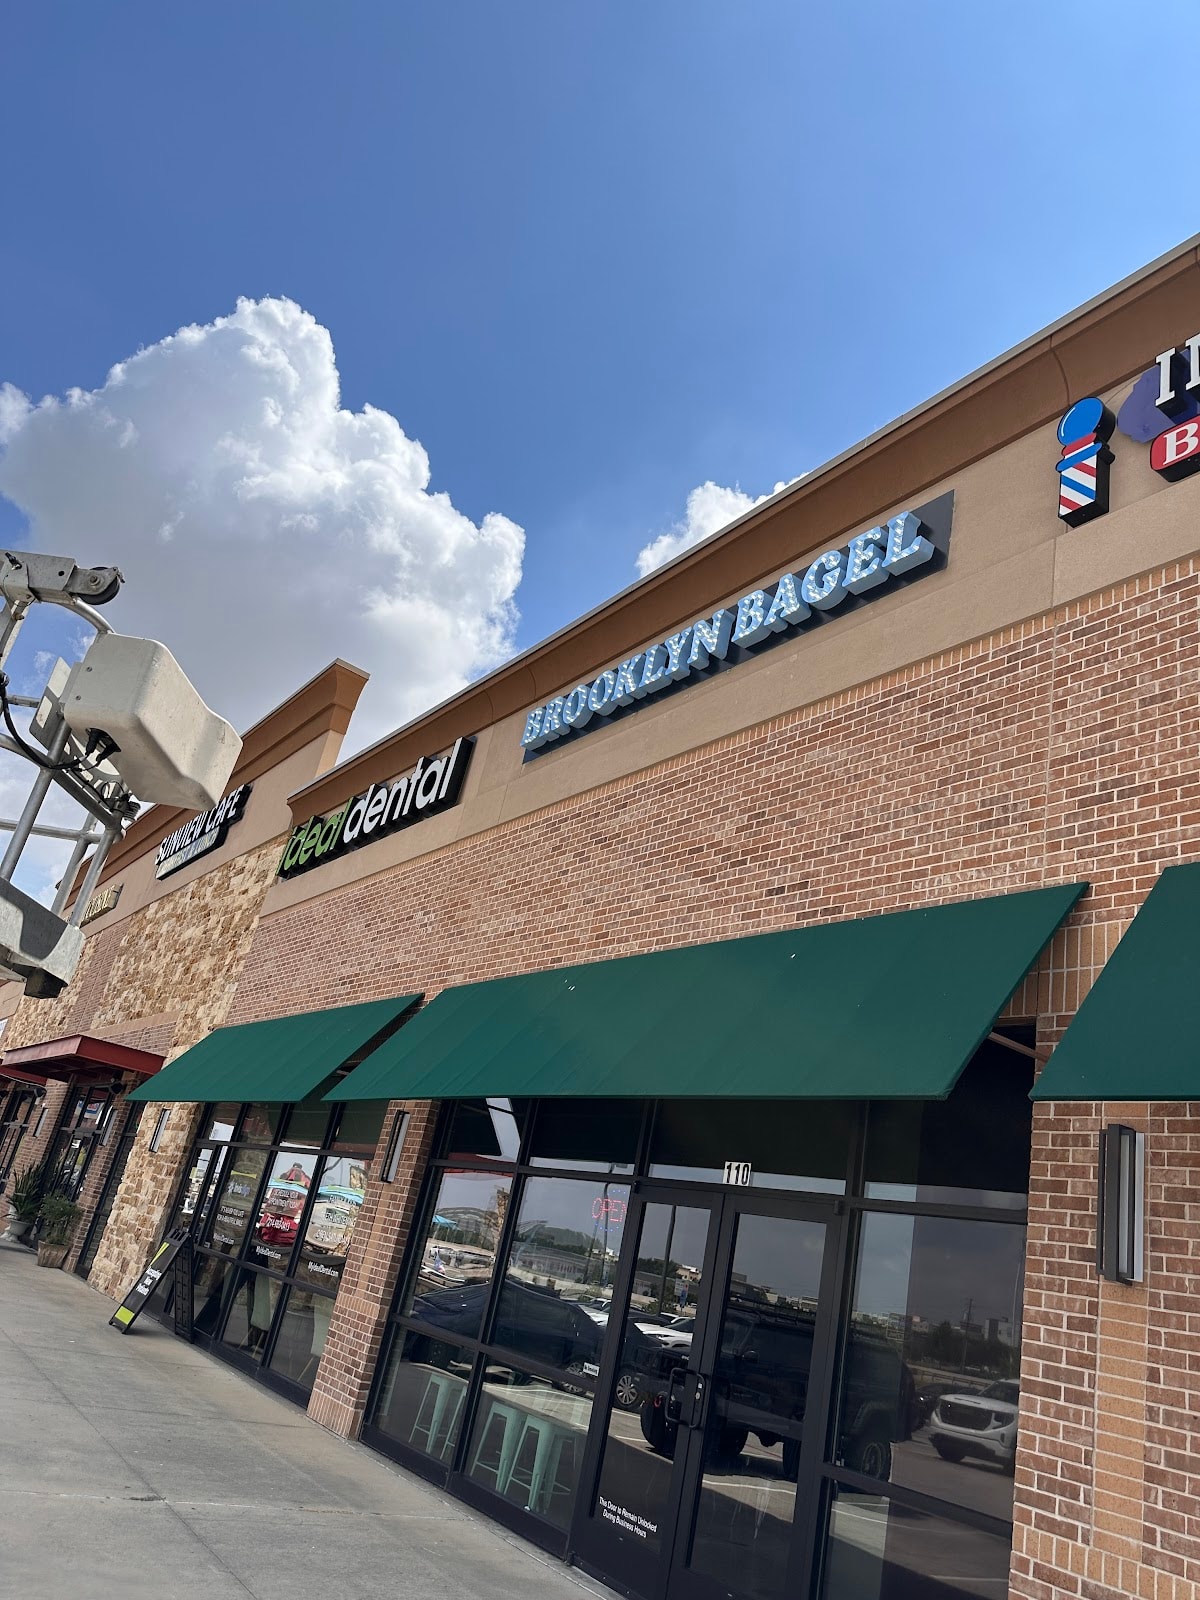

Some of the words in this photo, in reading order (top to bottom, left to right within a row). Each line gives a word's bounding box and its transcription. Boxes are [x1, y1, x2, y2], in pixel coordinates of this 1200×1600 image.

[520, 609, 735, 749] BROOKLYN
[731, 510, 928, 646] BAGEL
[155, 810, 208, 865] SUNVIEW
[205, 784, 244, 833] CAFE
[726, 1162, 749, 1185] 110
[603, 1509, 616, 1523] During
[616, 1516, 634, 1531] Business
[634, 1525, 646, 1538] Hours
[607, 1501, 617, 1512] Door
[622, 1508, 637, 1522] Remain
[638, 1516, 657, 1532] Unlocked
